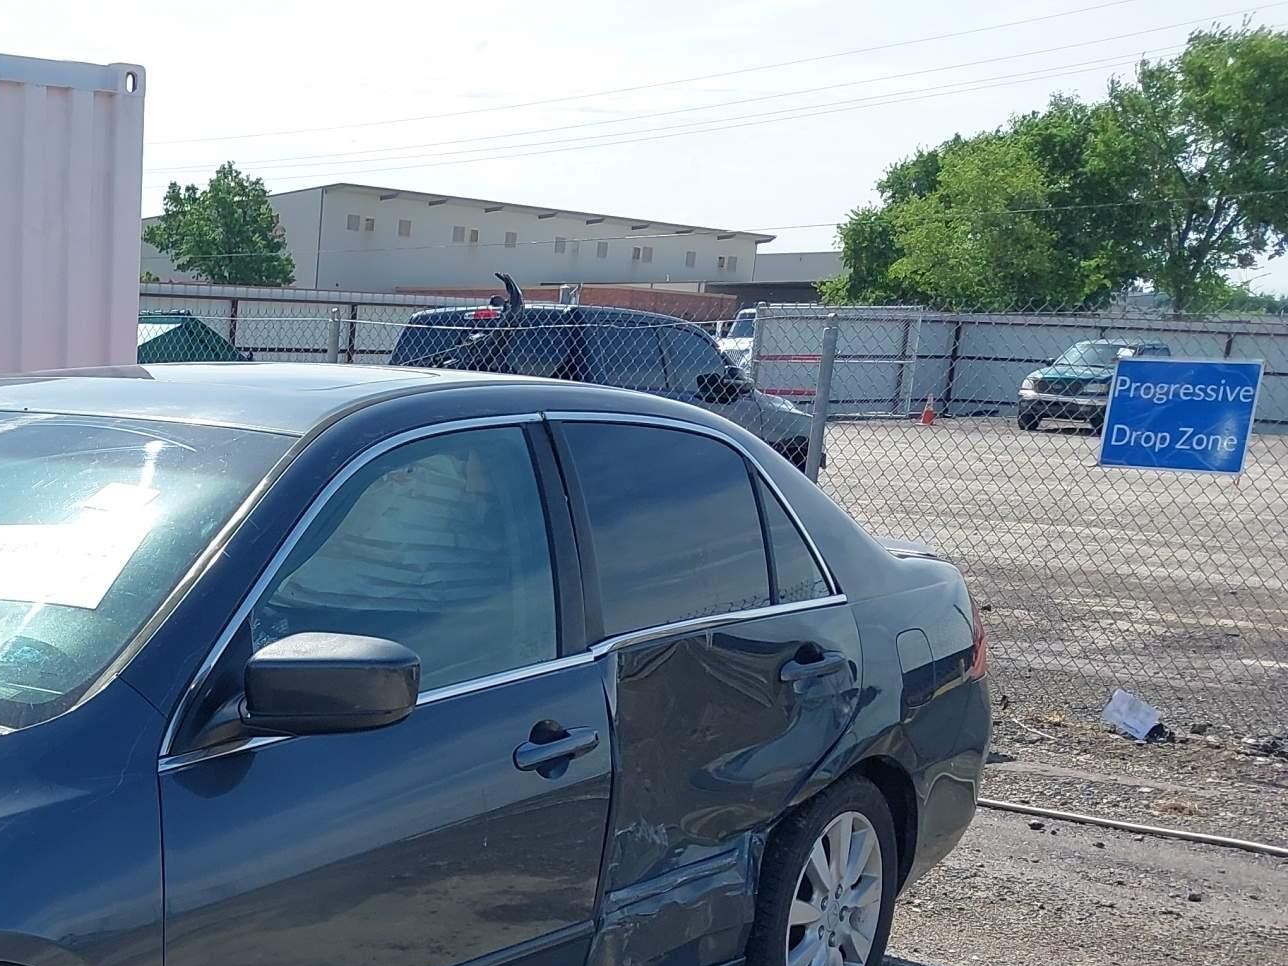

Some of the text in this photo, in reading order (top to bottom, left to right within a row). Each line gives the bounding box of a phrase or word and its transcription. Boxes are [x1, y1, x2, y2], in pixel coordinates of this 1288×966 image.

[1114, 376, 1254, 404] Progressive
[1111, 424, 1238, 453] Drop Zone
